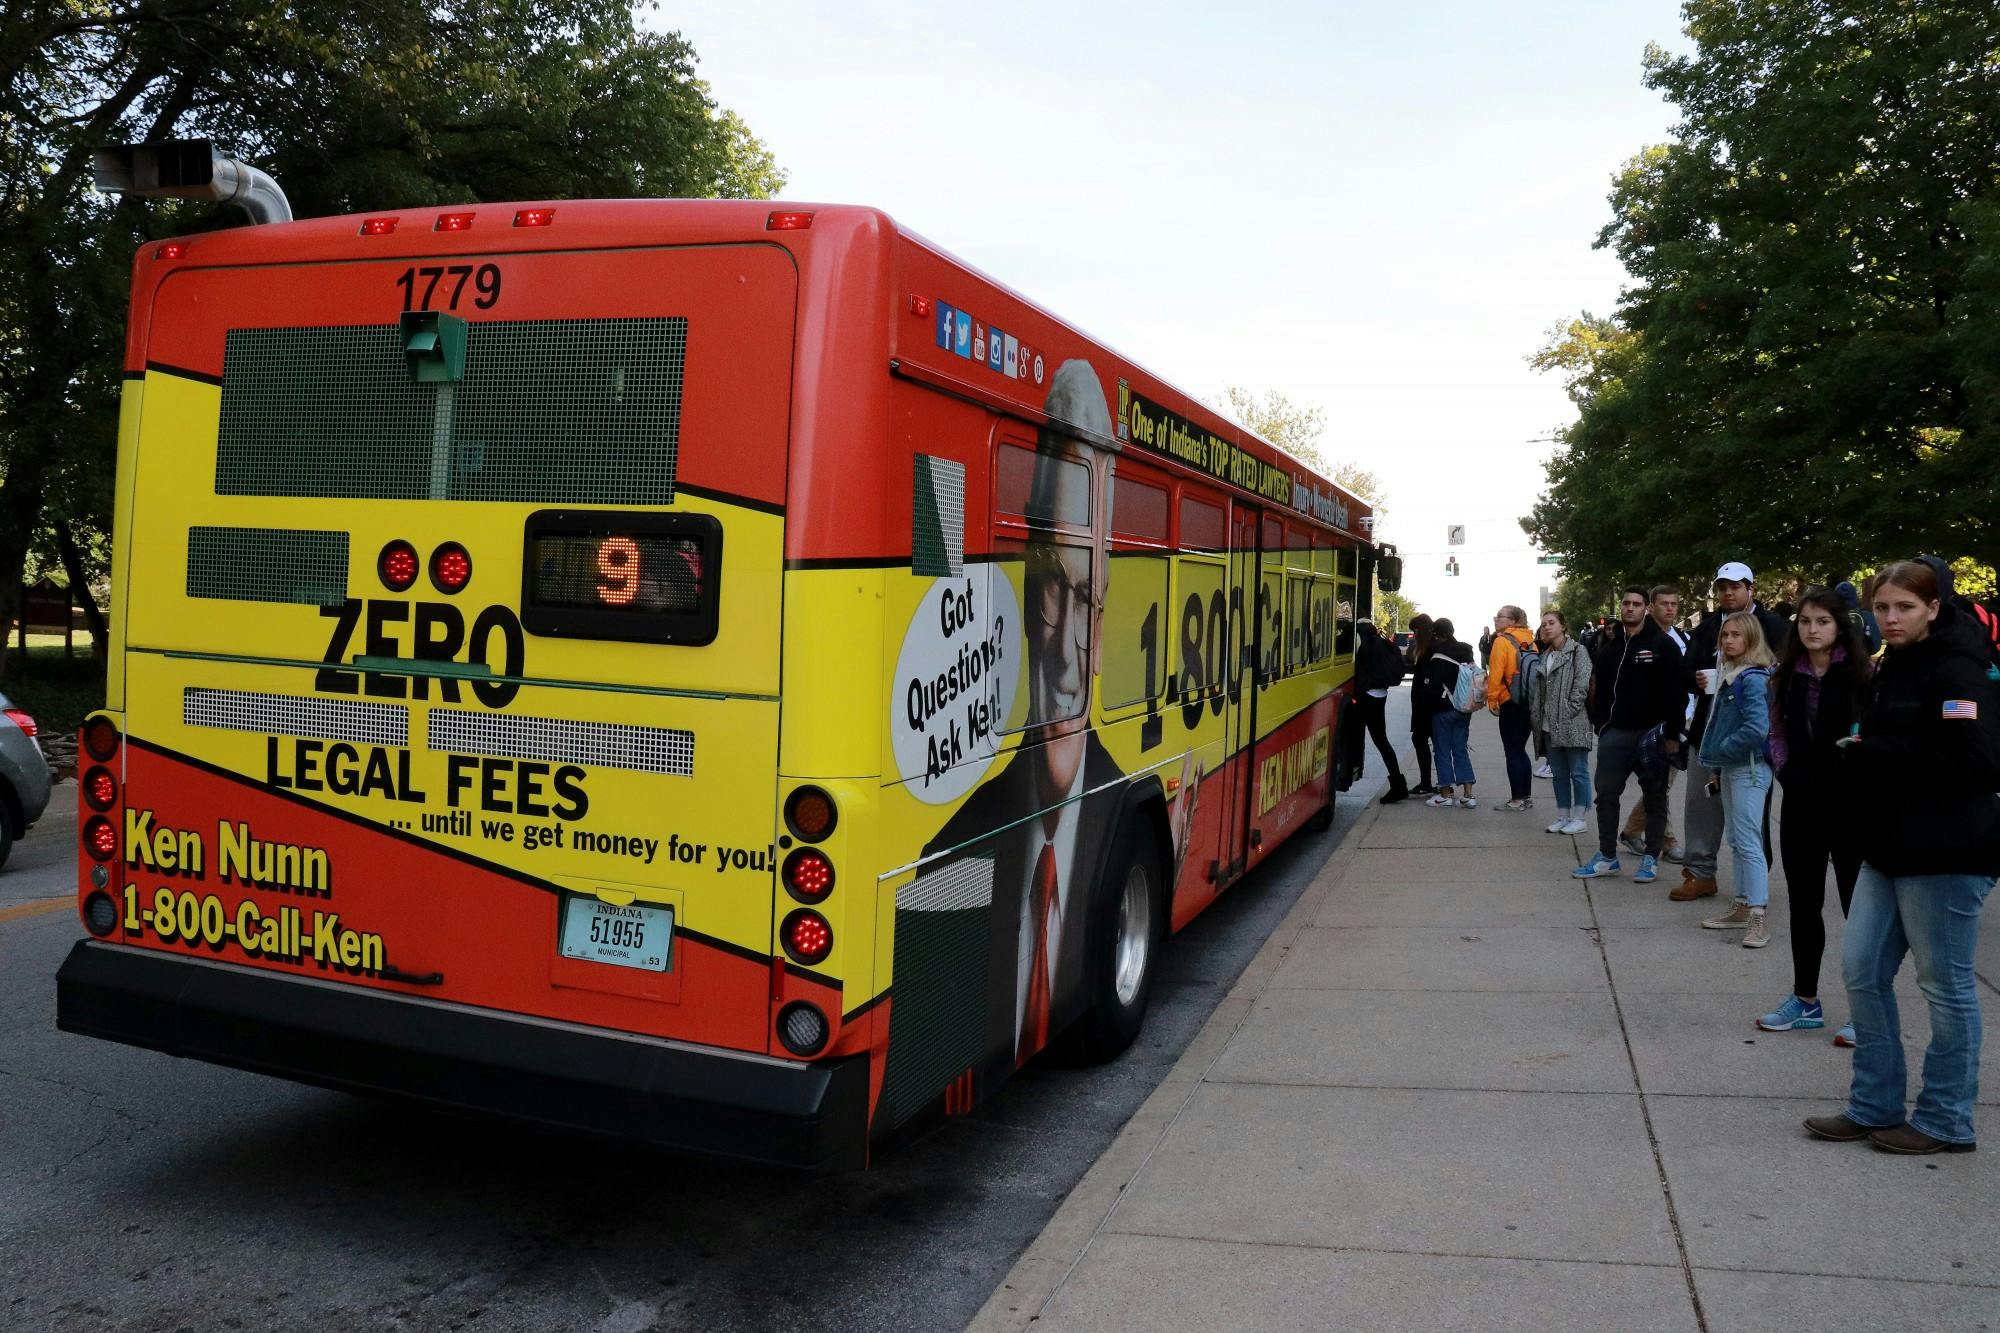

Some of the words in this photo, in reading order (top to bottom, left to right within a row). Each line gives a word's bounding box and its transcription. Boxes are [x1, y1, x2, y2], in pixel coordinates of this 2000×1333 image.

[396, 264, 502, 313] 1779
[1132, 401, 1154, 444] One
[1157, 416, 1168, 449] of
[1169, 419, 1208, 467] Indiana's
[1209, 435, 1229, 477] TOP
[1230, 447, 1258, 490] RATED
[1258, 462, 1290, 504] LAWYERS
[597, 536, 640, 604] 9
[940, 578, 974, 638] Got
[315, 598, 525, 708] ZERO
[907, 615, 1004, 732] Questions?
[924, 718, 963, 788] Ask
[967, 677, 1002, 750] Ken!
[266, 736, 426, 804] LEGAL
[447, 754, 590, 821] FEES
[1258, 750, 1284, 816] KEN
[125, 808, 203, 874] Ken
[218, 820, 330, 893] Nunn
[421, 811, 472, 837] until
[480, 819, 515, 842] we
[522, 822, 564, 851] get
[572, 831, 659, 864] money
[668, 834, 707, 864] for
[716, 844, 777, 872] you!
[124, 883, 385, 974] 1-800-Call-Ken
[590, 916, 645, 949] 51955
[596, 904, 643, 919] INDIANA
[597, 947, 631, 959] MUNICIPAL
[648, 956, 660, 966] 53
